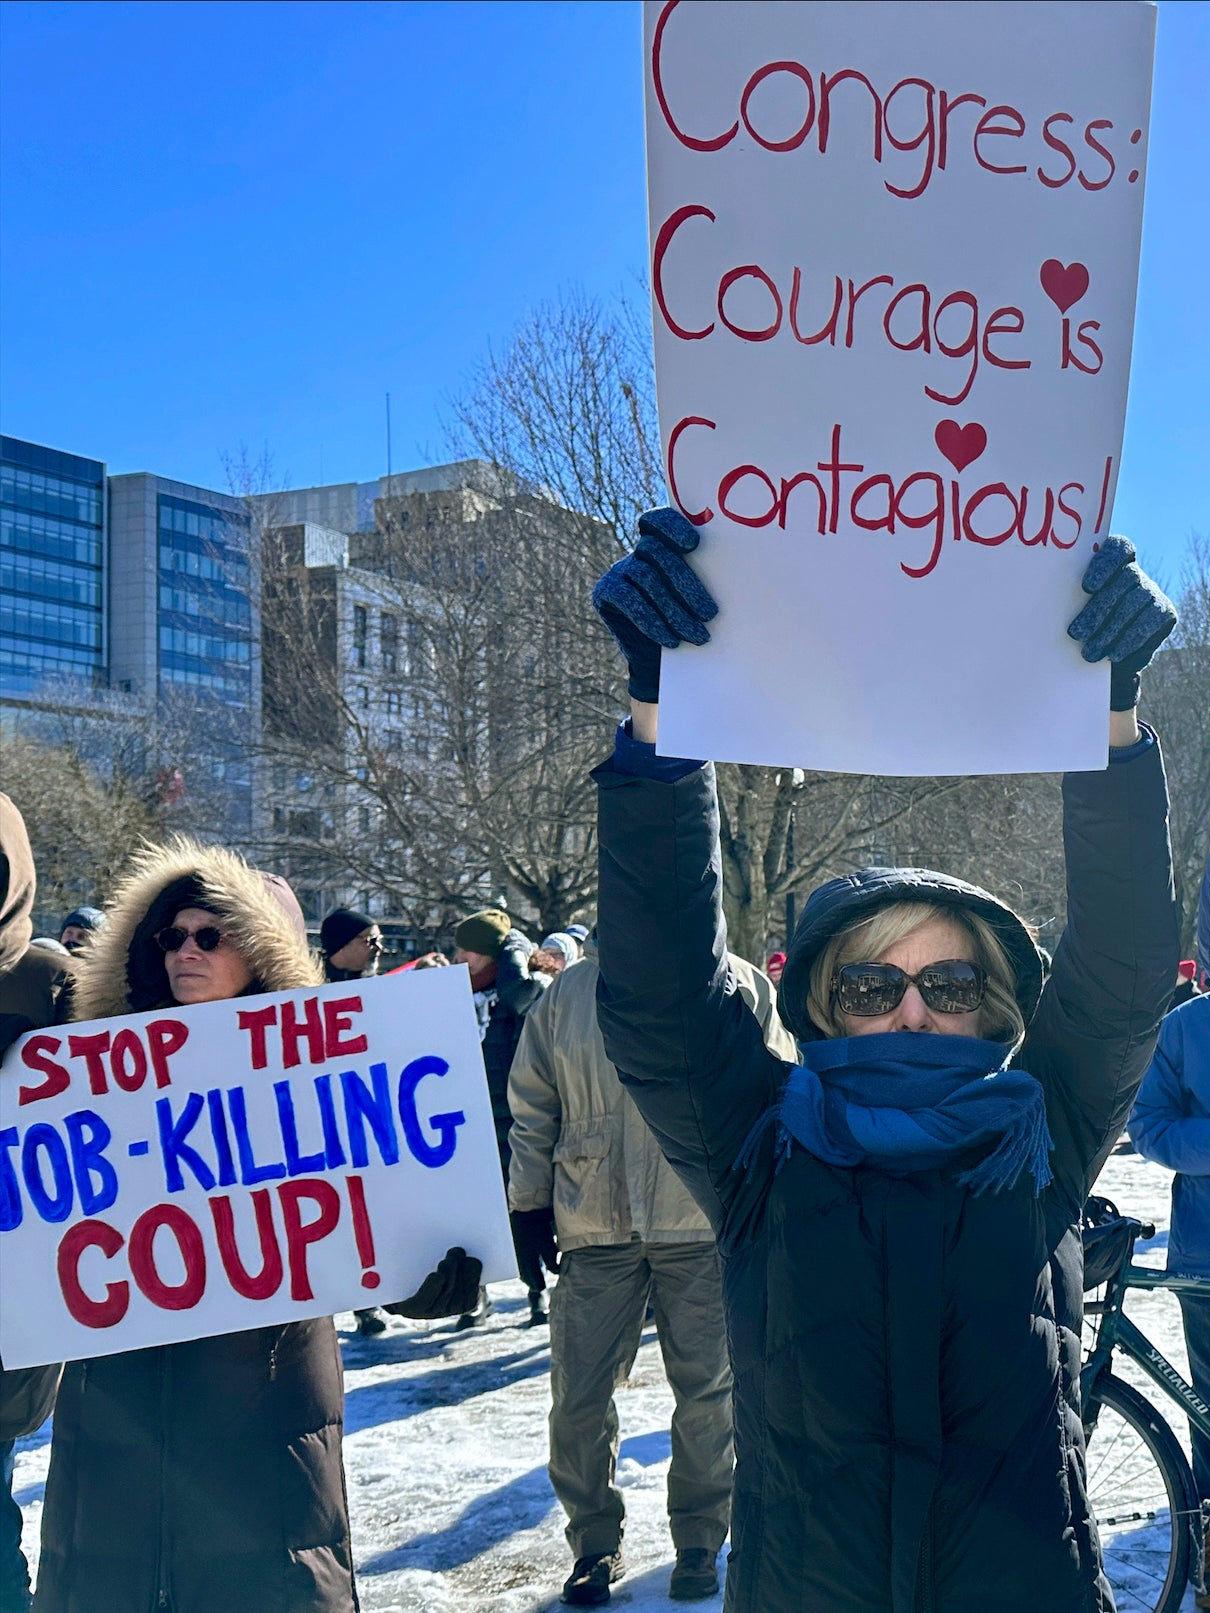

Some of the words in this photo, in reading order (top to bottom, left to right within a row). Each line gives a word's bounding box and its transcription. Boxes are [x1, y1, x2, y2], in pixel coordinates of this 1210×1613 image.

[652, 0, 1142, 199] Congress:
[653, 205, 1031, 405] Courage
[669, 416, 1112, 578] Contagious!
[19, 1020, 189, 1106] STOP
[236, 996, 368, 1070] THE
[57, 1175, 381, 1329] COUP!
[1146, 1349, 1209, 1415] SPECIALIZED
